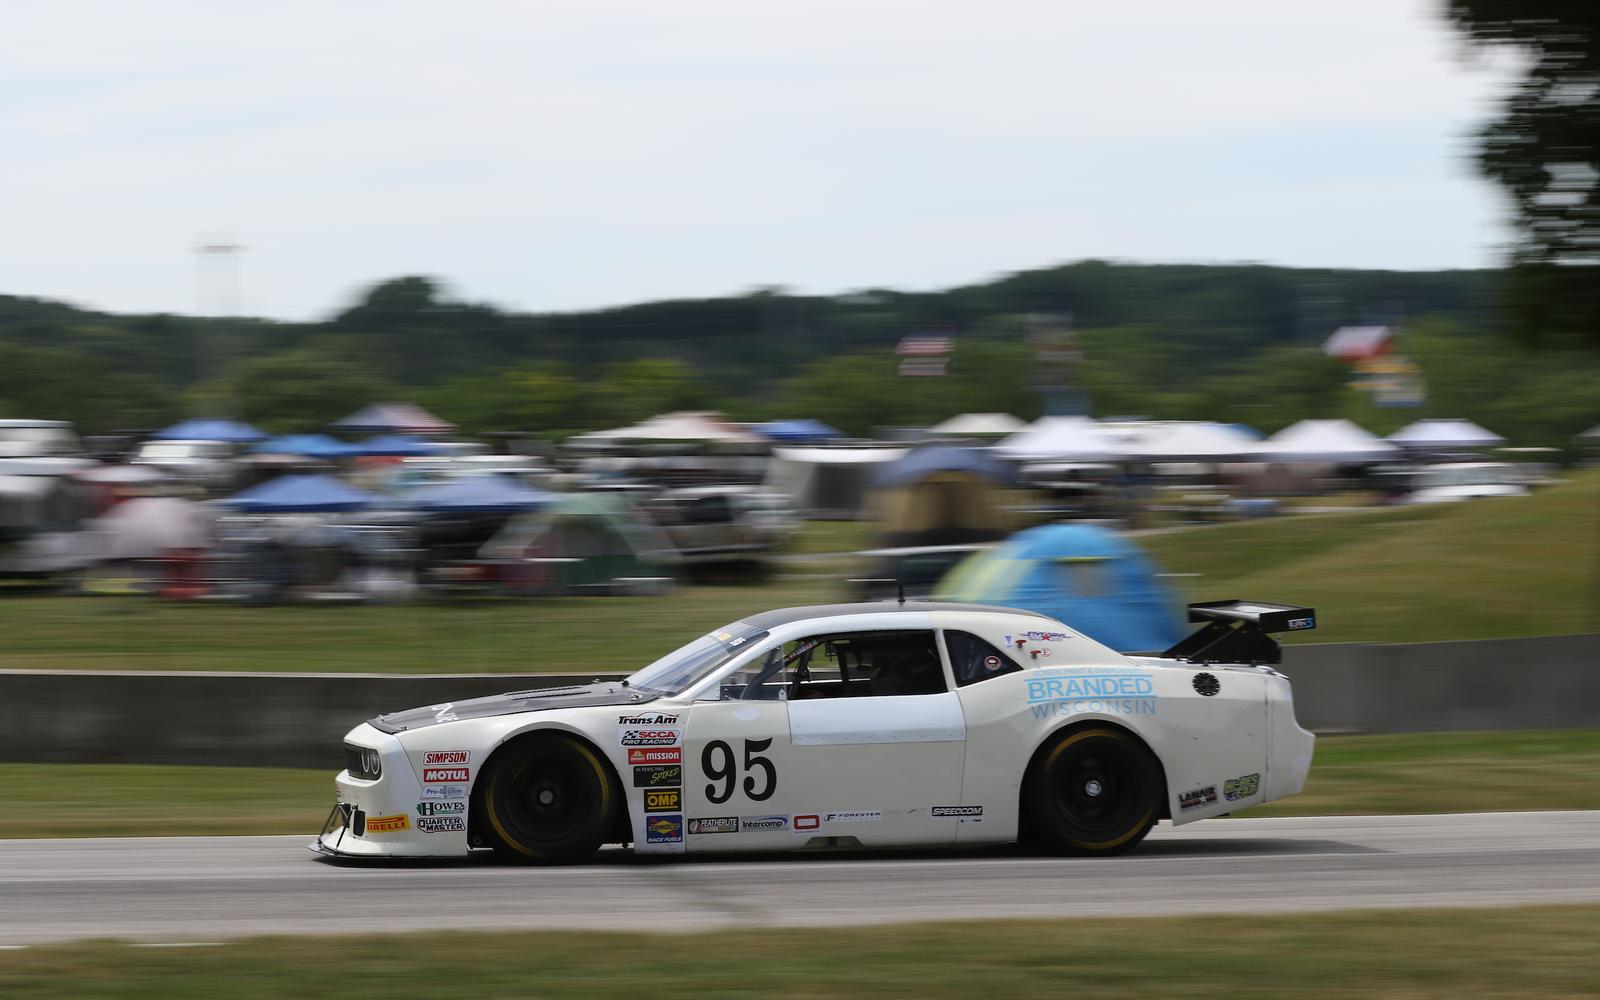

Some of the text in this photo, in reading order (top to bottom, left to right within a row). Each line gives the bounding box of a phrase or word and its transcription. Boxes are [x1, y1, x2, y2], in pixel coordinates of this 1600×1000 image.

[1027, 678, 1152, 700] BRANDED
[1031, 700, 1156, 719] WISCONSIN
[619, 715, 677, 724] Trans Am
[426, 752, 467, 764] SIMPSON
[426, 770, 467, 780] MOTUL
[701, 737, 777, 804] 95
[1179, 787, 1215, 801] LANAIR
[647, 794, 678, 806] OMP
[421, 802, 461, 816] HOWE
[932, 807, 982, 815] SPEEDCOM
[418, 818, 461, 828] QUARTER
[426, 823, 463, 832] MASTER
[702, 818, 737, 827] FEATHERLITE
[742, 819, 783, 829] Intercomp
